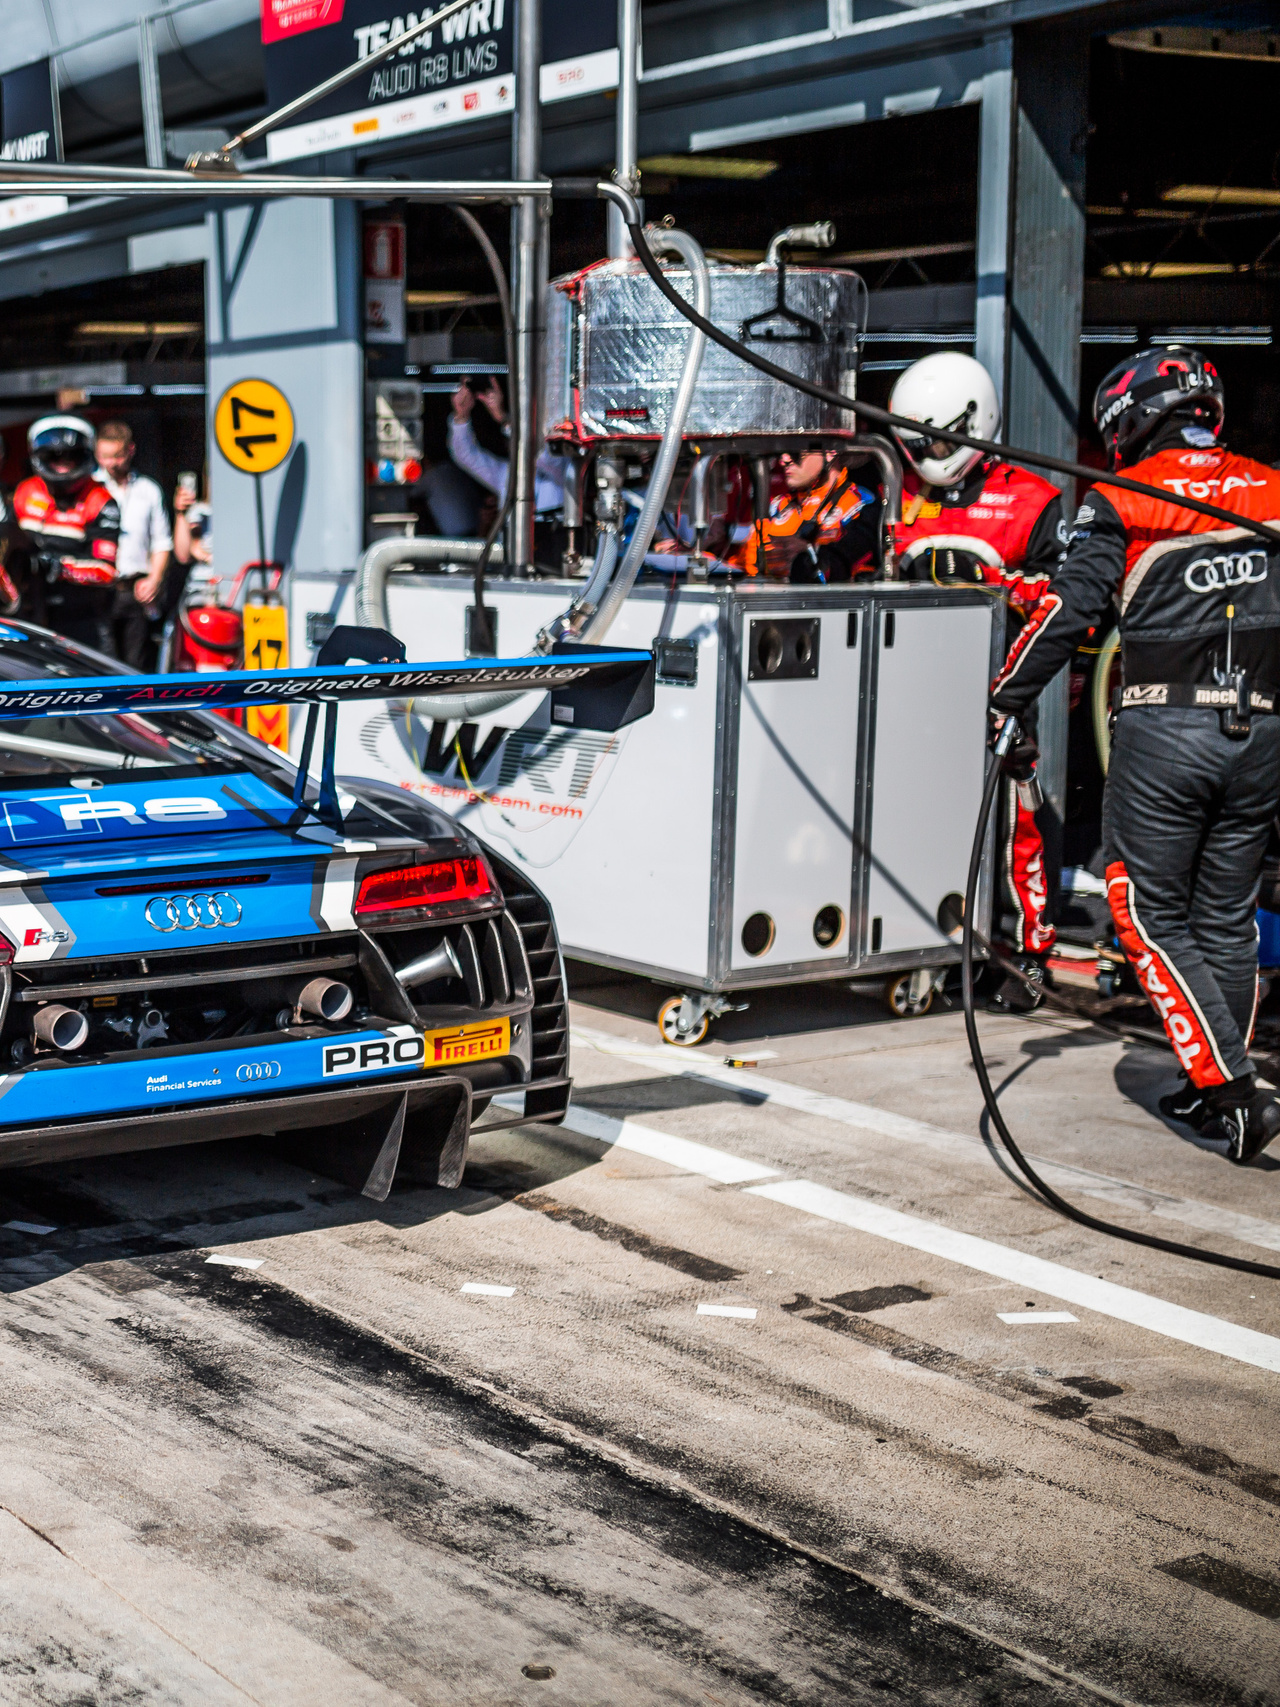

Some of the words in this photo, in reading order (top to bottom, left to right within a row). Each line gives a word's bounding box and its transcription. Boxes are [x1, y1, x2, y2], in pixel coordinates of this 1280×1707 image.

[368, 61, 417, 101] AUDI
[420, 53, 449, 88] R8
[452, 39, 498, 80] LMS
[231, 397, 277, 459] 17
[1163, 472, 1267, 498] TOTAL
[252, 639, 282, 671] 17
[125, 683, 226, 701] Audi
[243, 677, 381, 698] Originele
[388, 666, 591, 689] Wisselstukken
[423, 719, 620, 799] WRT
[326, 1038, 424, 1073] PRO
[434, 1027, 503, 1061] PIRELLI
[147, 1075, 168, 1084] Audi
[147, 1081, 185, 1093] Financial
[187, 1078, 222, 1089] Services
